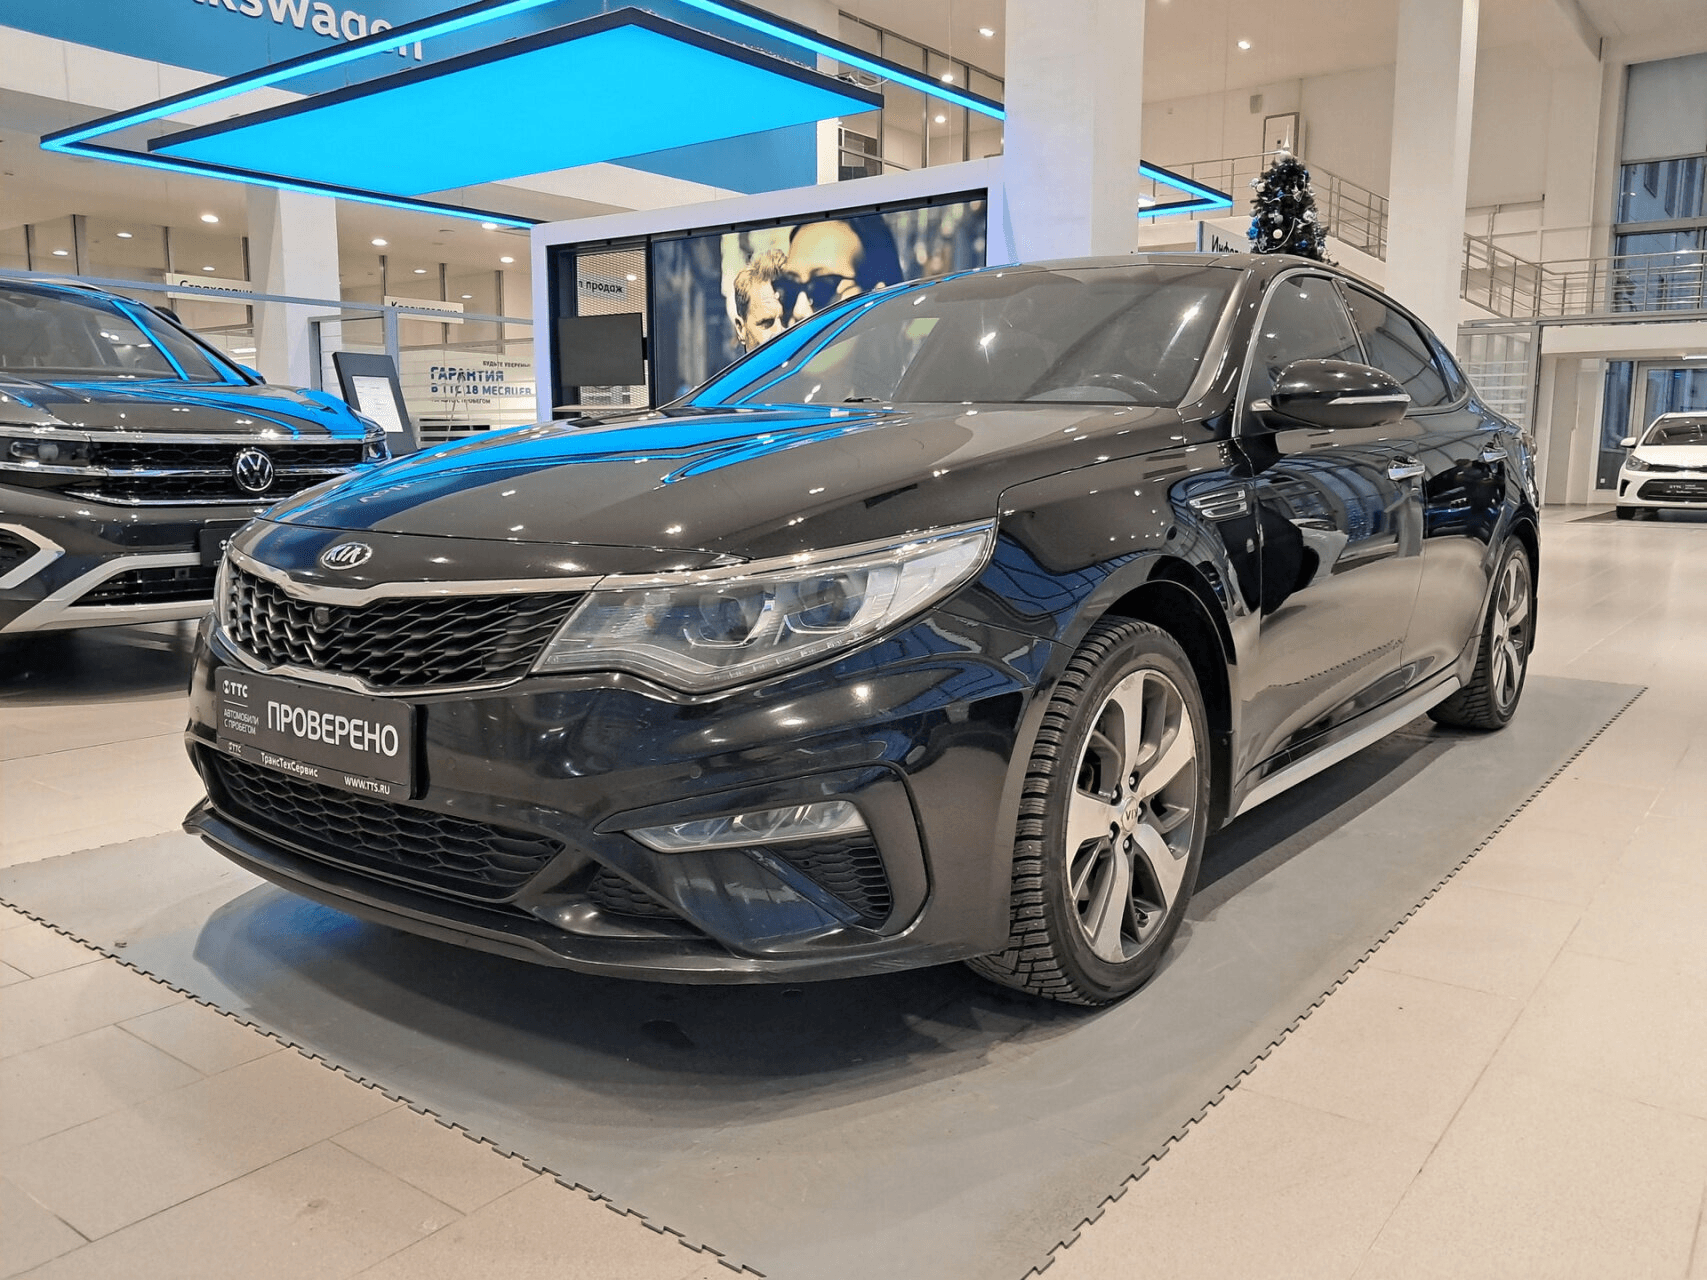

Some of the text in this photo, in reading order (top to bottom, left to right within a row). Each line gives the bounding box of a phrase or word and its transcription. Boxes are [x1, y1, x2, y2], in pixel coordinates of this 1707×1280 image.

[586, 281, 623, 293] продаж
[430, 366, 504, 382] ГАРАНТИЯ
[465, 385, 479, 395] 18
[230, 682, 248, 698] ТТС
[223, 708, 260, 726] АВТОМОБИЛИ
[224, 718, 256, 735] С ПРОБЕГОМ
[267, 700, 399, 757] ПРОВЕРЕНО
[260, 752, 319, 778] ТрансТехСервис
[343, 775, 391, 795] WWW.TTS.RU
